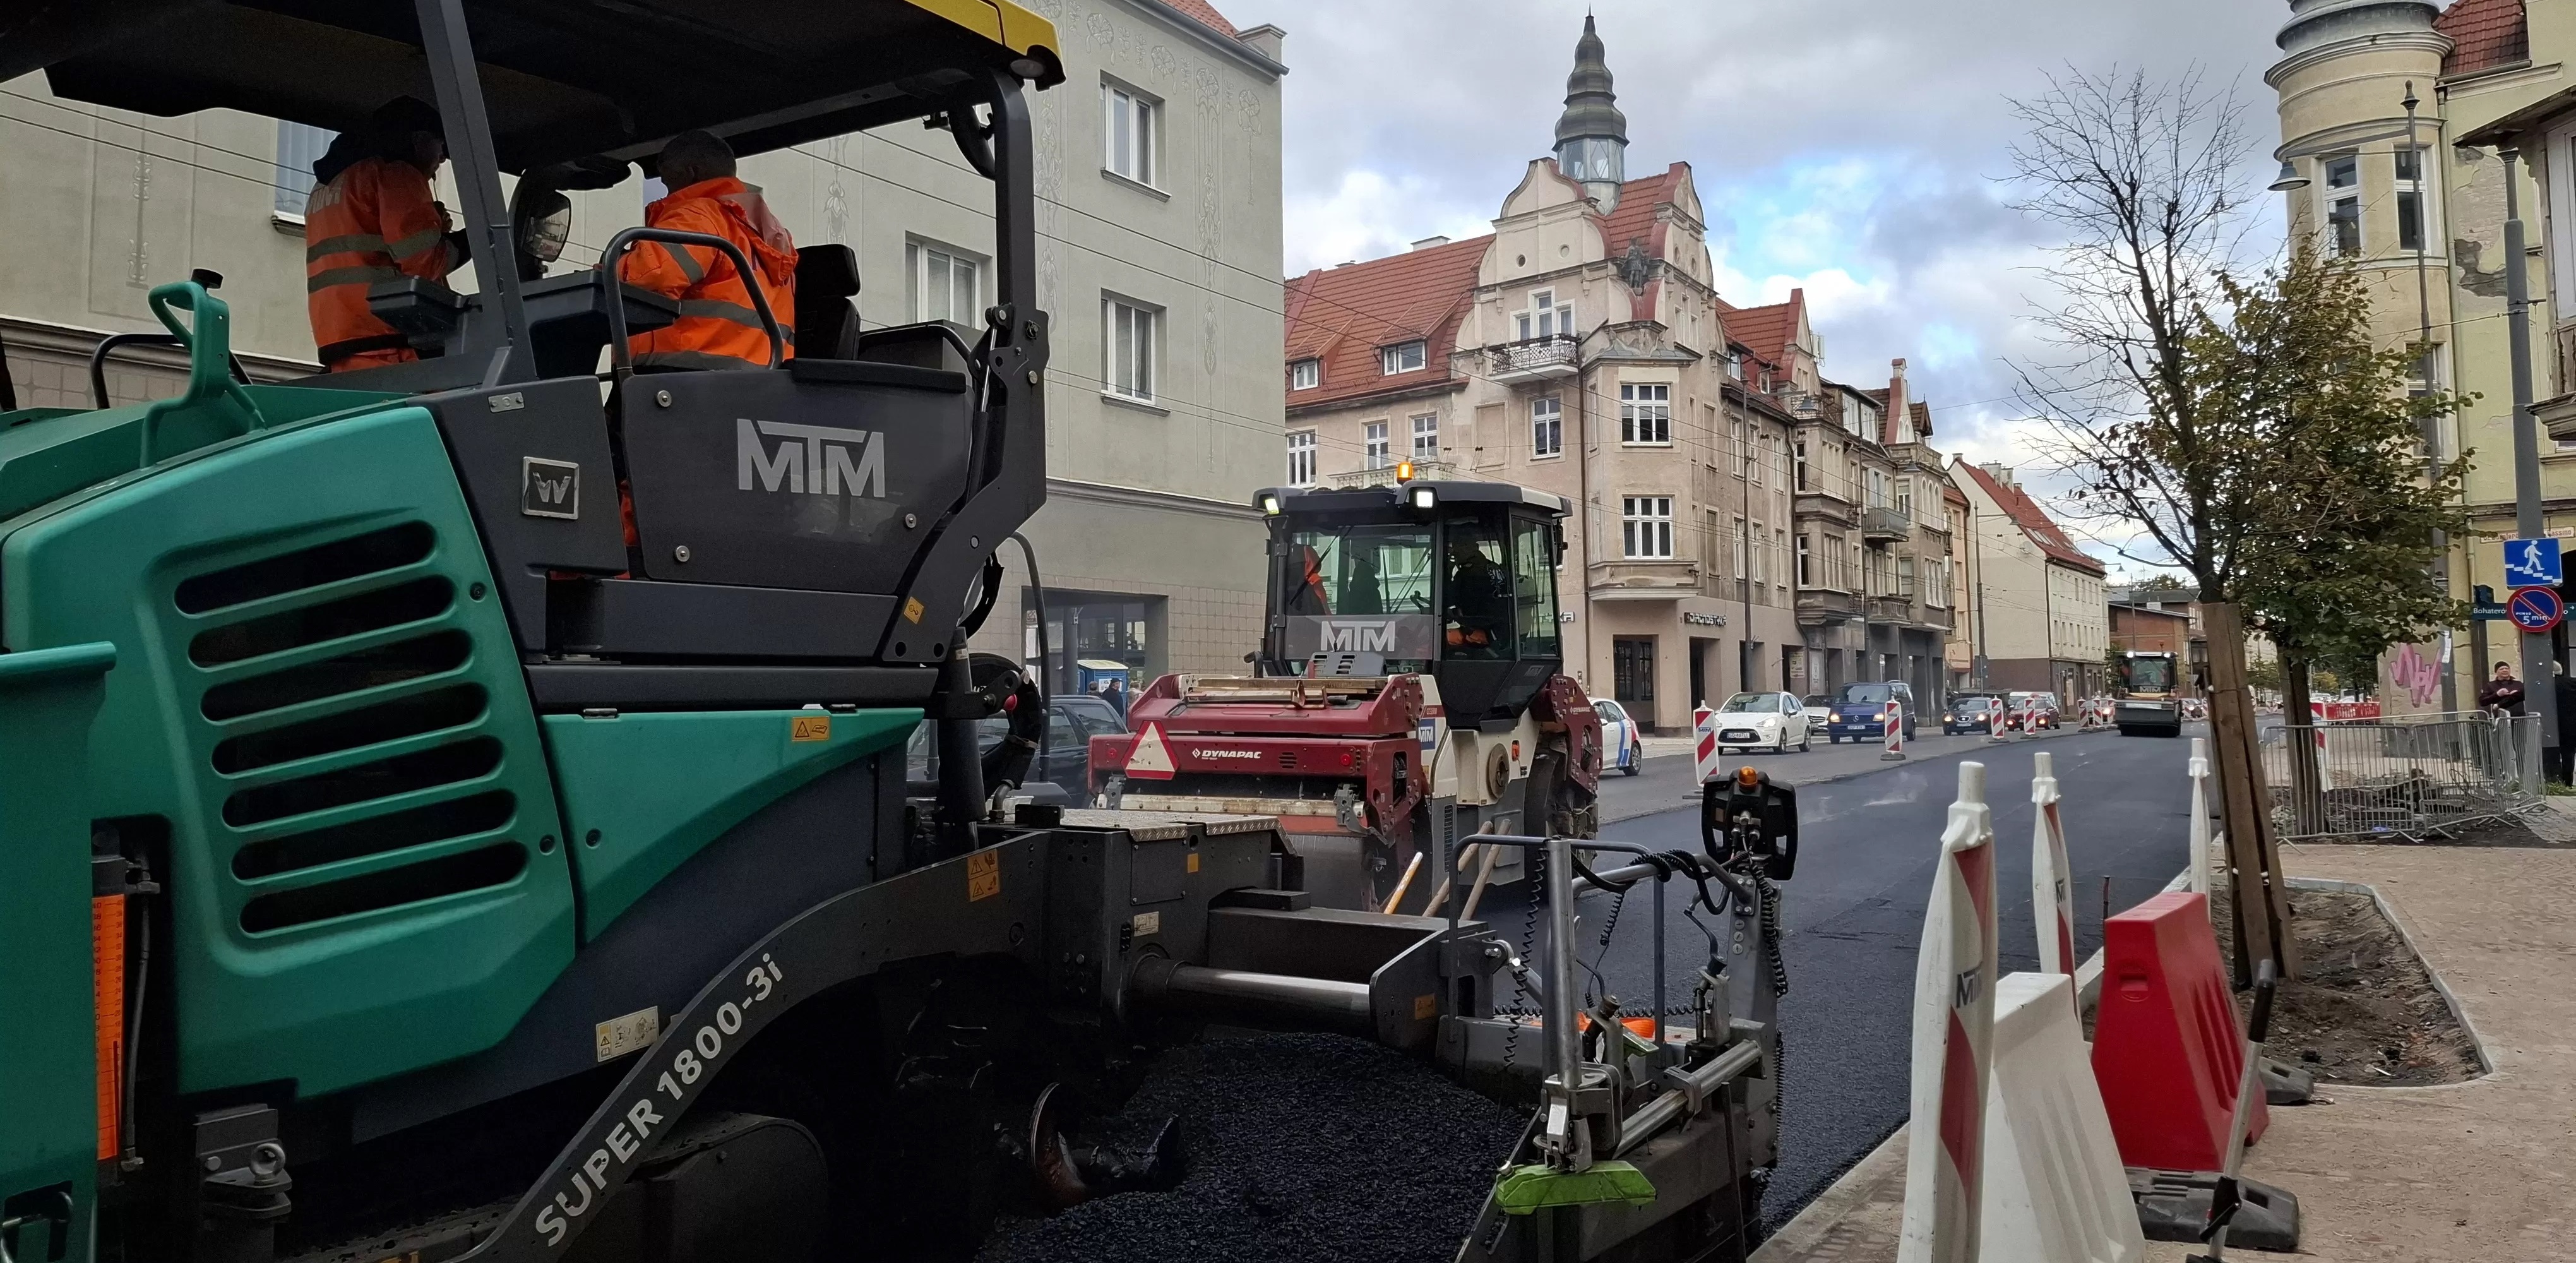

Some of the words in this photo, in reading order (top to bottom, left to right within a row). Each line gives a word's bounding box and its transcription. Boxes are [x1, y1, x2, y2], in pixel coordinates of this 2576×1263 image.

[737, 419, 885, 498] MTM
[2523, 616, 2530, 625] 5
[1321, 621, 1395, 652] MTM
[1419, 726, 1433, 743] MTM
[1202, 750, 1261, 759] DYNAPAC
[535, 1099, 664, 1247] SUPER
[657, 952, 784, 1101] 1800-3i
